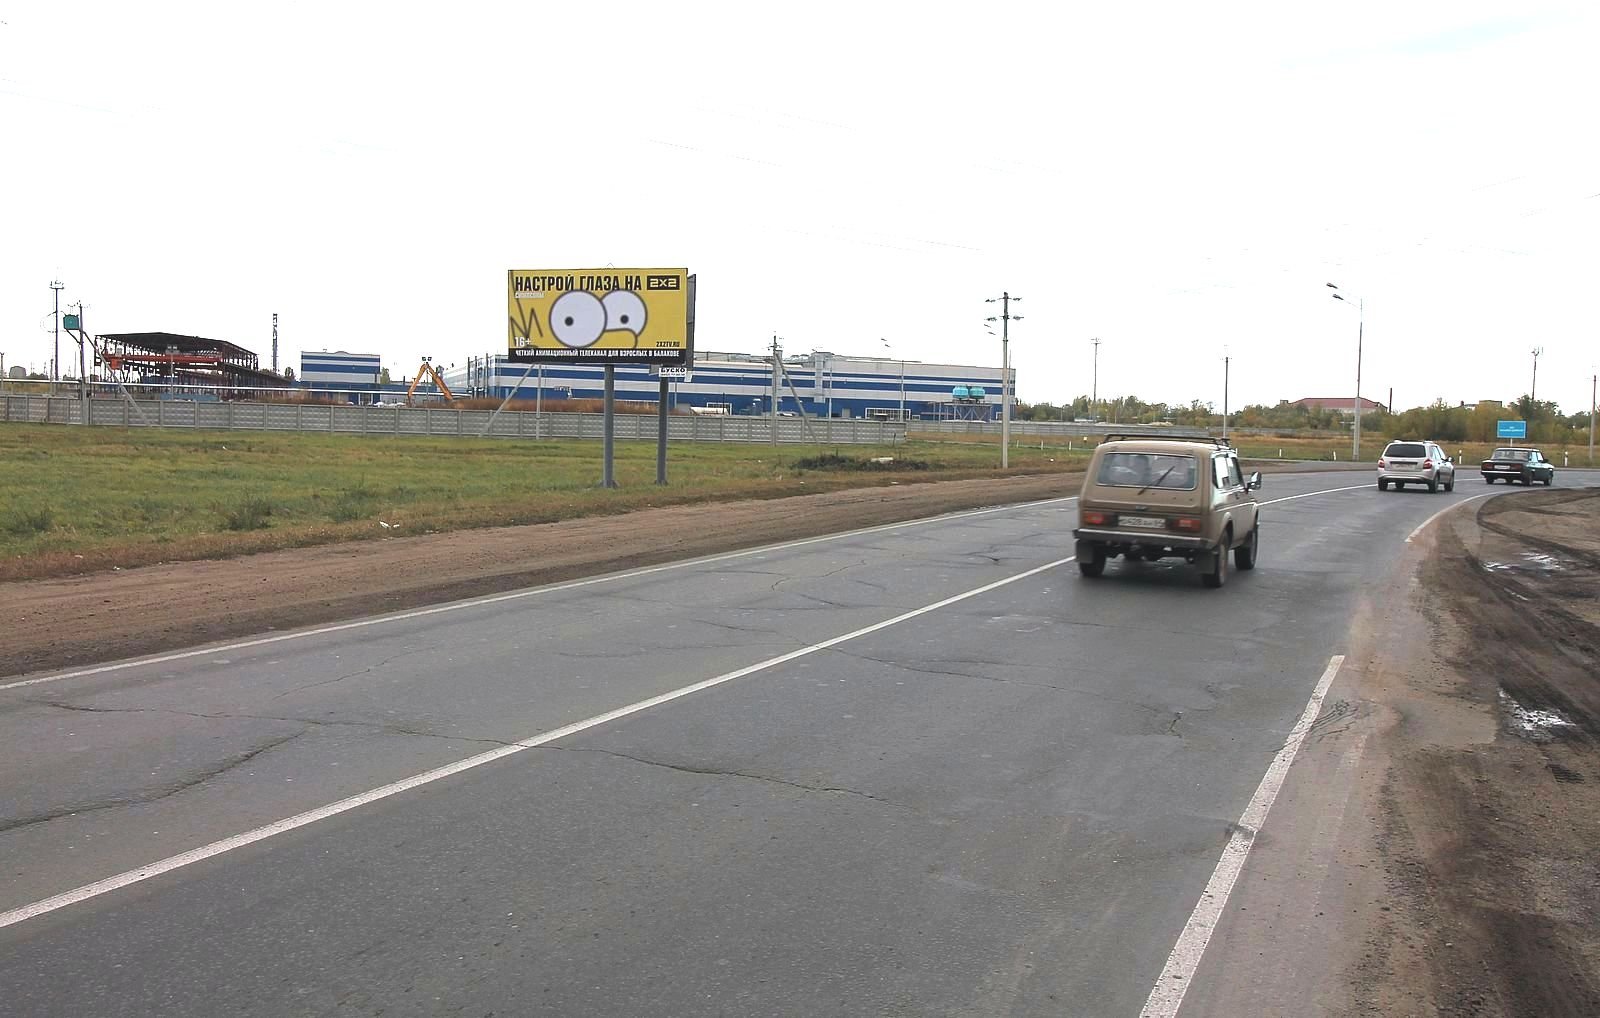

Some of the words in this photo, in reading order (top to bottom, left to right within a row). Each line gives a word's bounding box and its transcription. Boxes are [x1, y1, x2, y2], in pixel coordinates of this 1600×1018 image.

[515, 274, 574, 291] НАСТРОЙ
[580, 275, 620, 291] ГЛАЗА
[625, 275, 641, 291] НА
[515, 336, 531, 347] 16+
[515, 349, 534, 357] ЧЕТКИЙ
[535, 349, 579, 357] АНИМАЦИОННЫЙ
[580, 349, 607, 357] ТЕЛЕКАНАЛ
[608, 349, 618, 357] ДЛЯ
[619, 349, 648, 357] ВЗРОСЛЫХ
[653, 349, 680, 357] БАЛАКОВЕ
